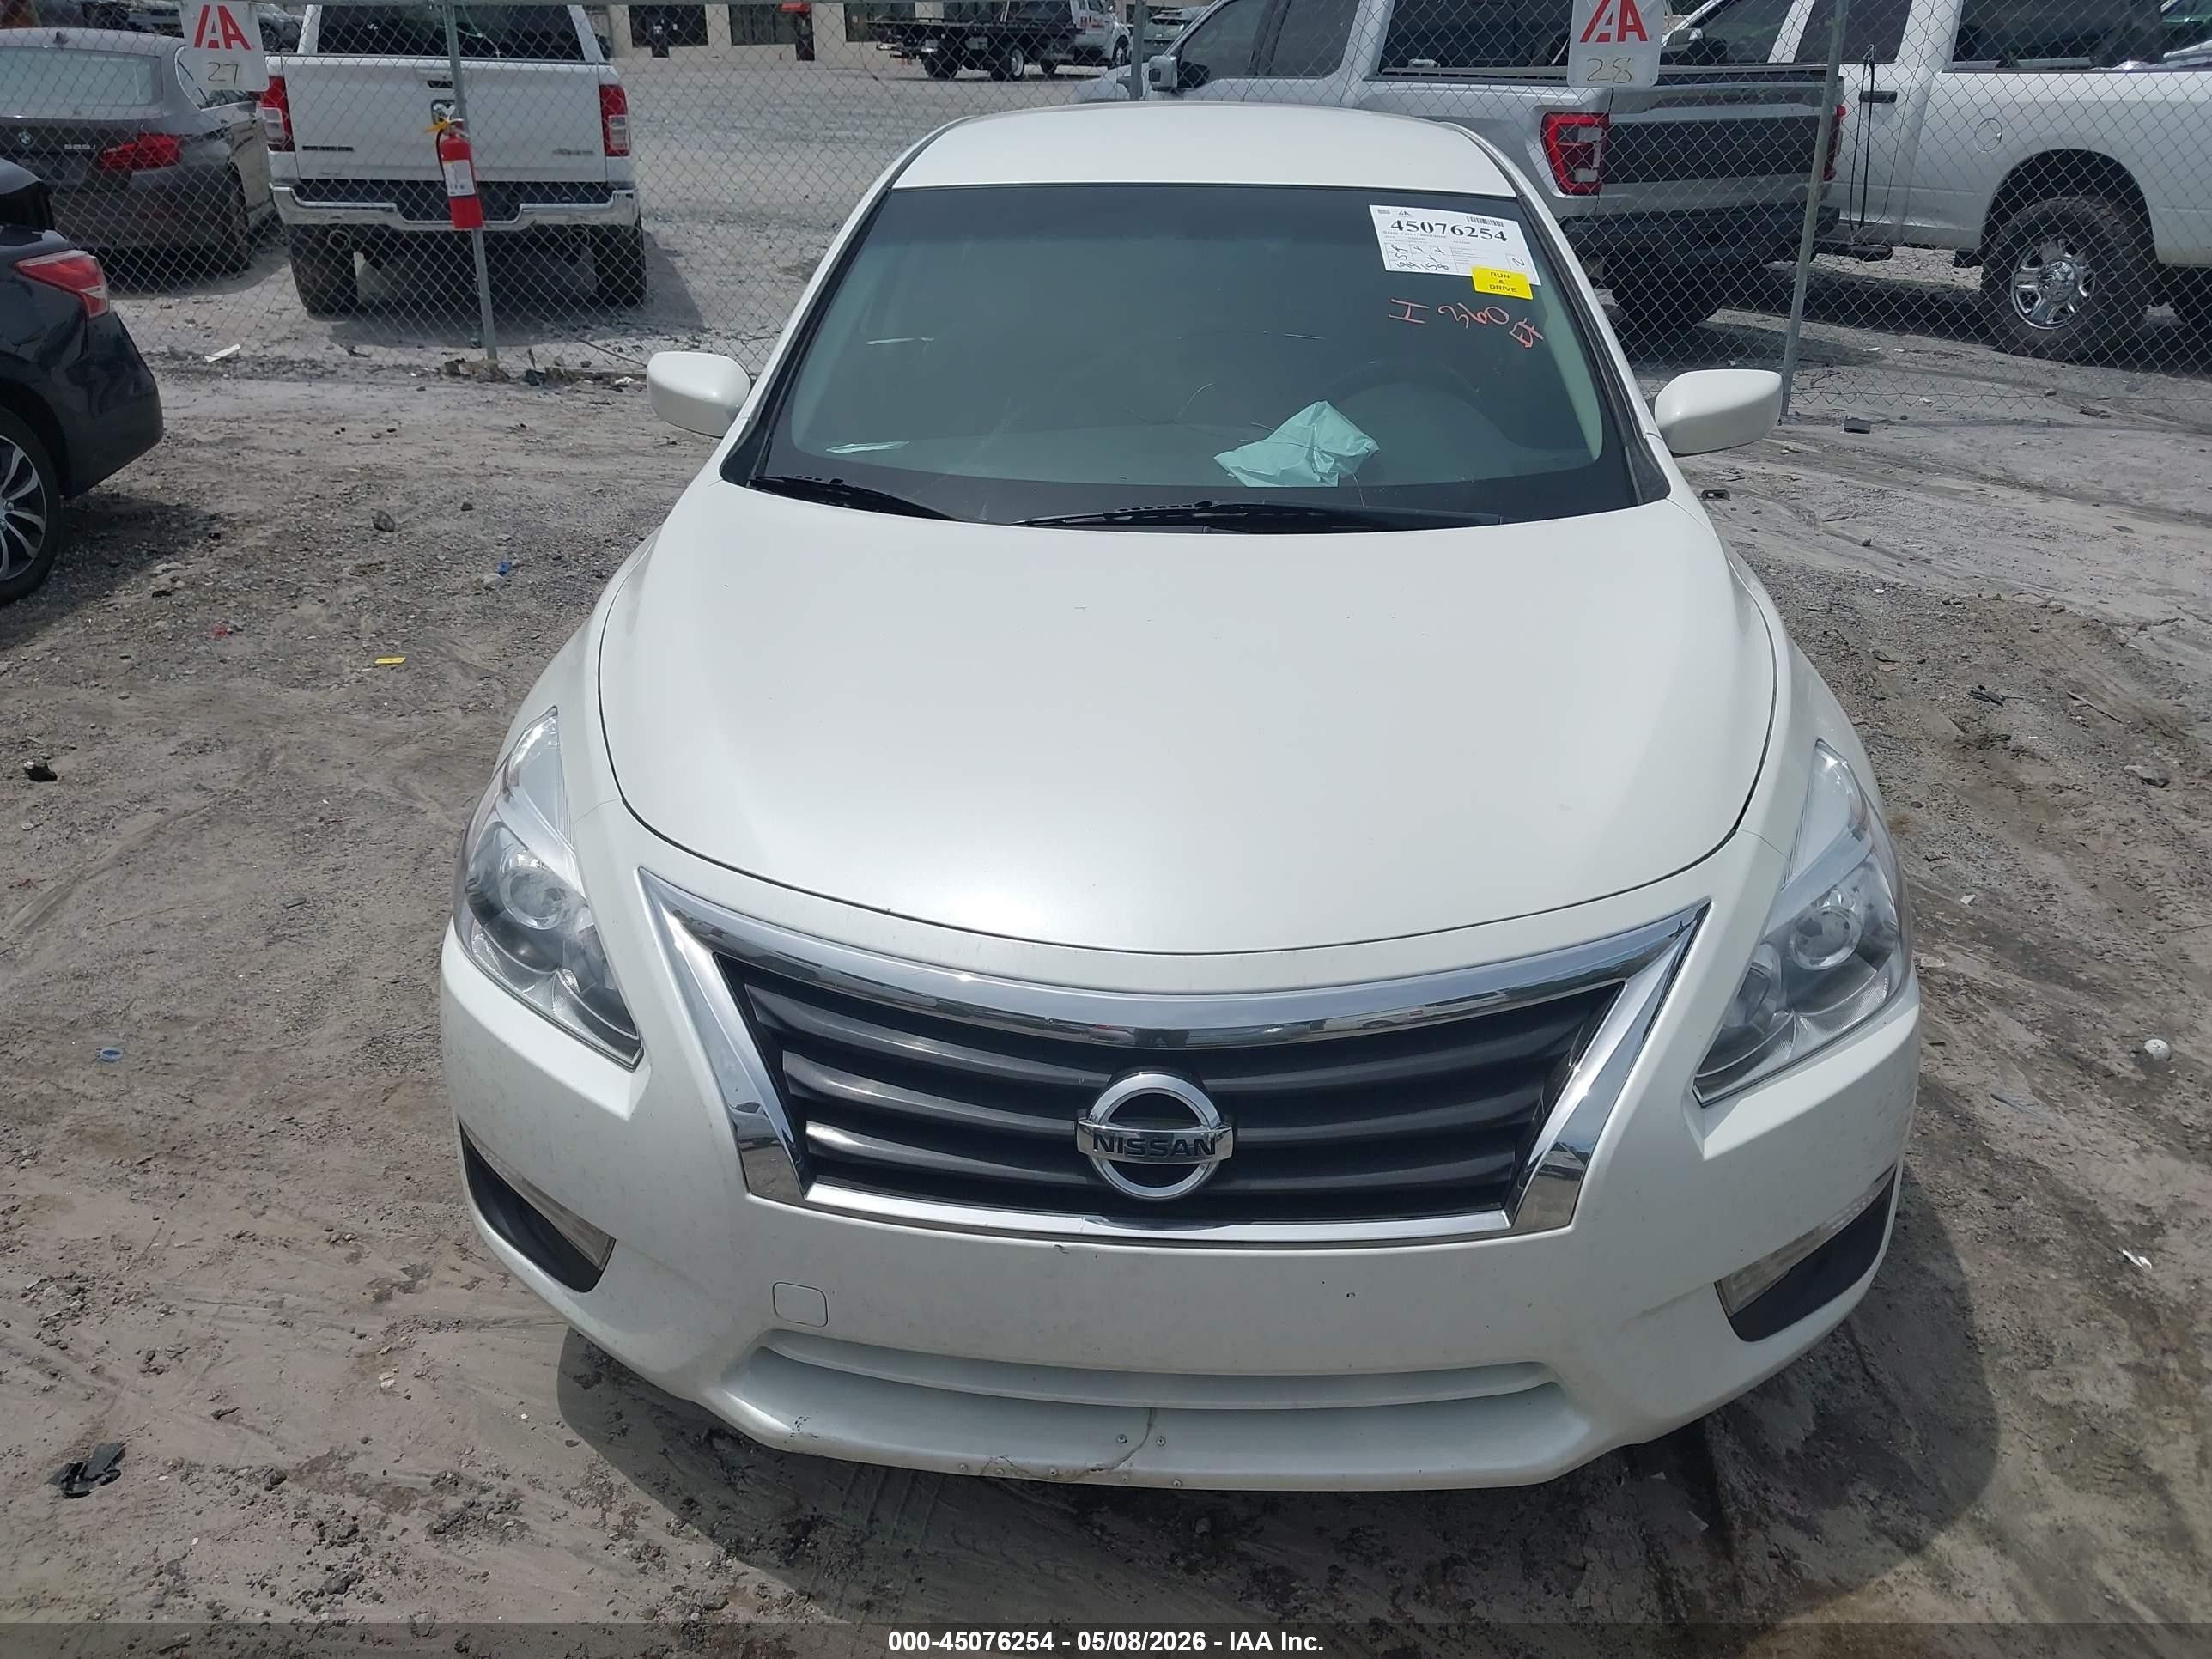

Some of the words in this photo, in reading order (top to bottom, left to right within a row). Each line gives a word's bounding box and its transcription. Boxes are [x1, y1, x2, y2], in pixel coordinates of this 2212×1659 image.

[206, 61, 240, 86] 27
[1586, 57, 1632, 84] 28
[1390, 219, 1508, 243] 45076254
[1490, 270, 1510, 279] RUN
[1488, 283, 1518, 293] DRIVE
[1093, 1133, 1217, 1157] NISSAN
